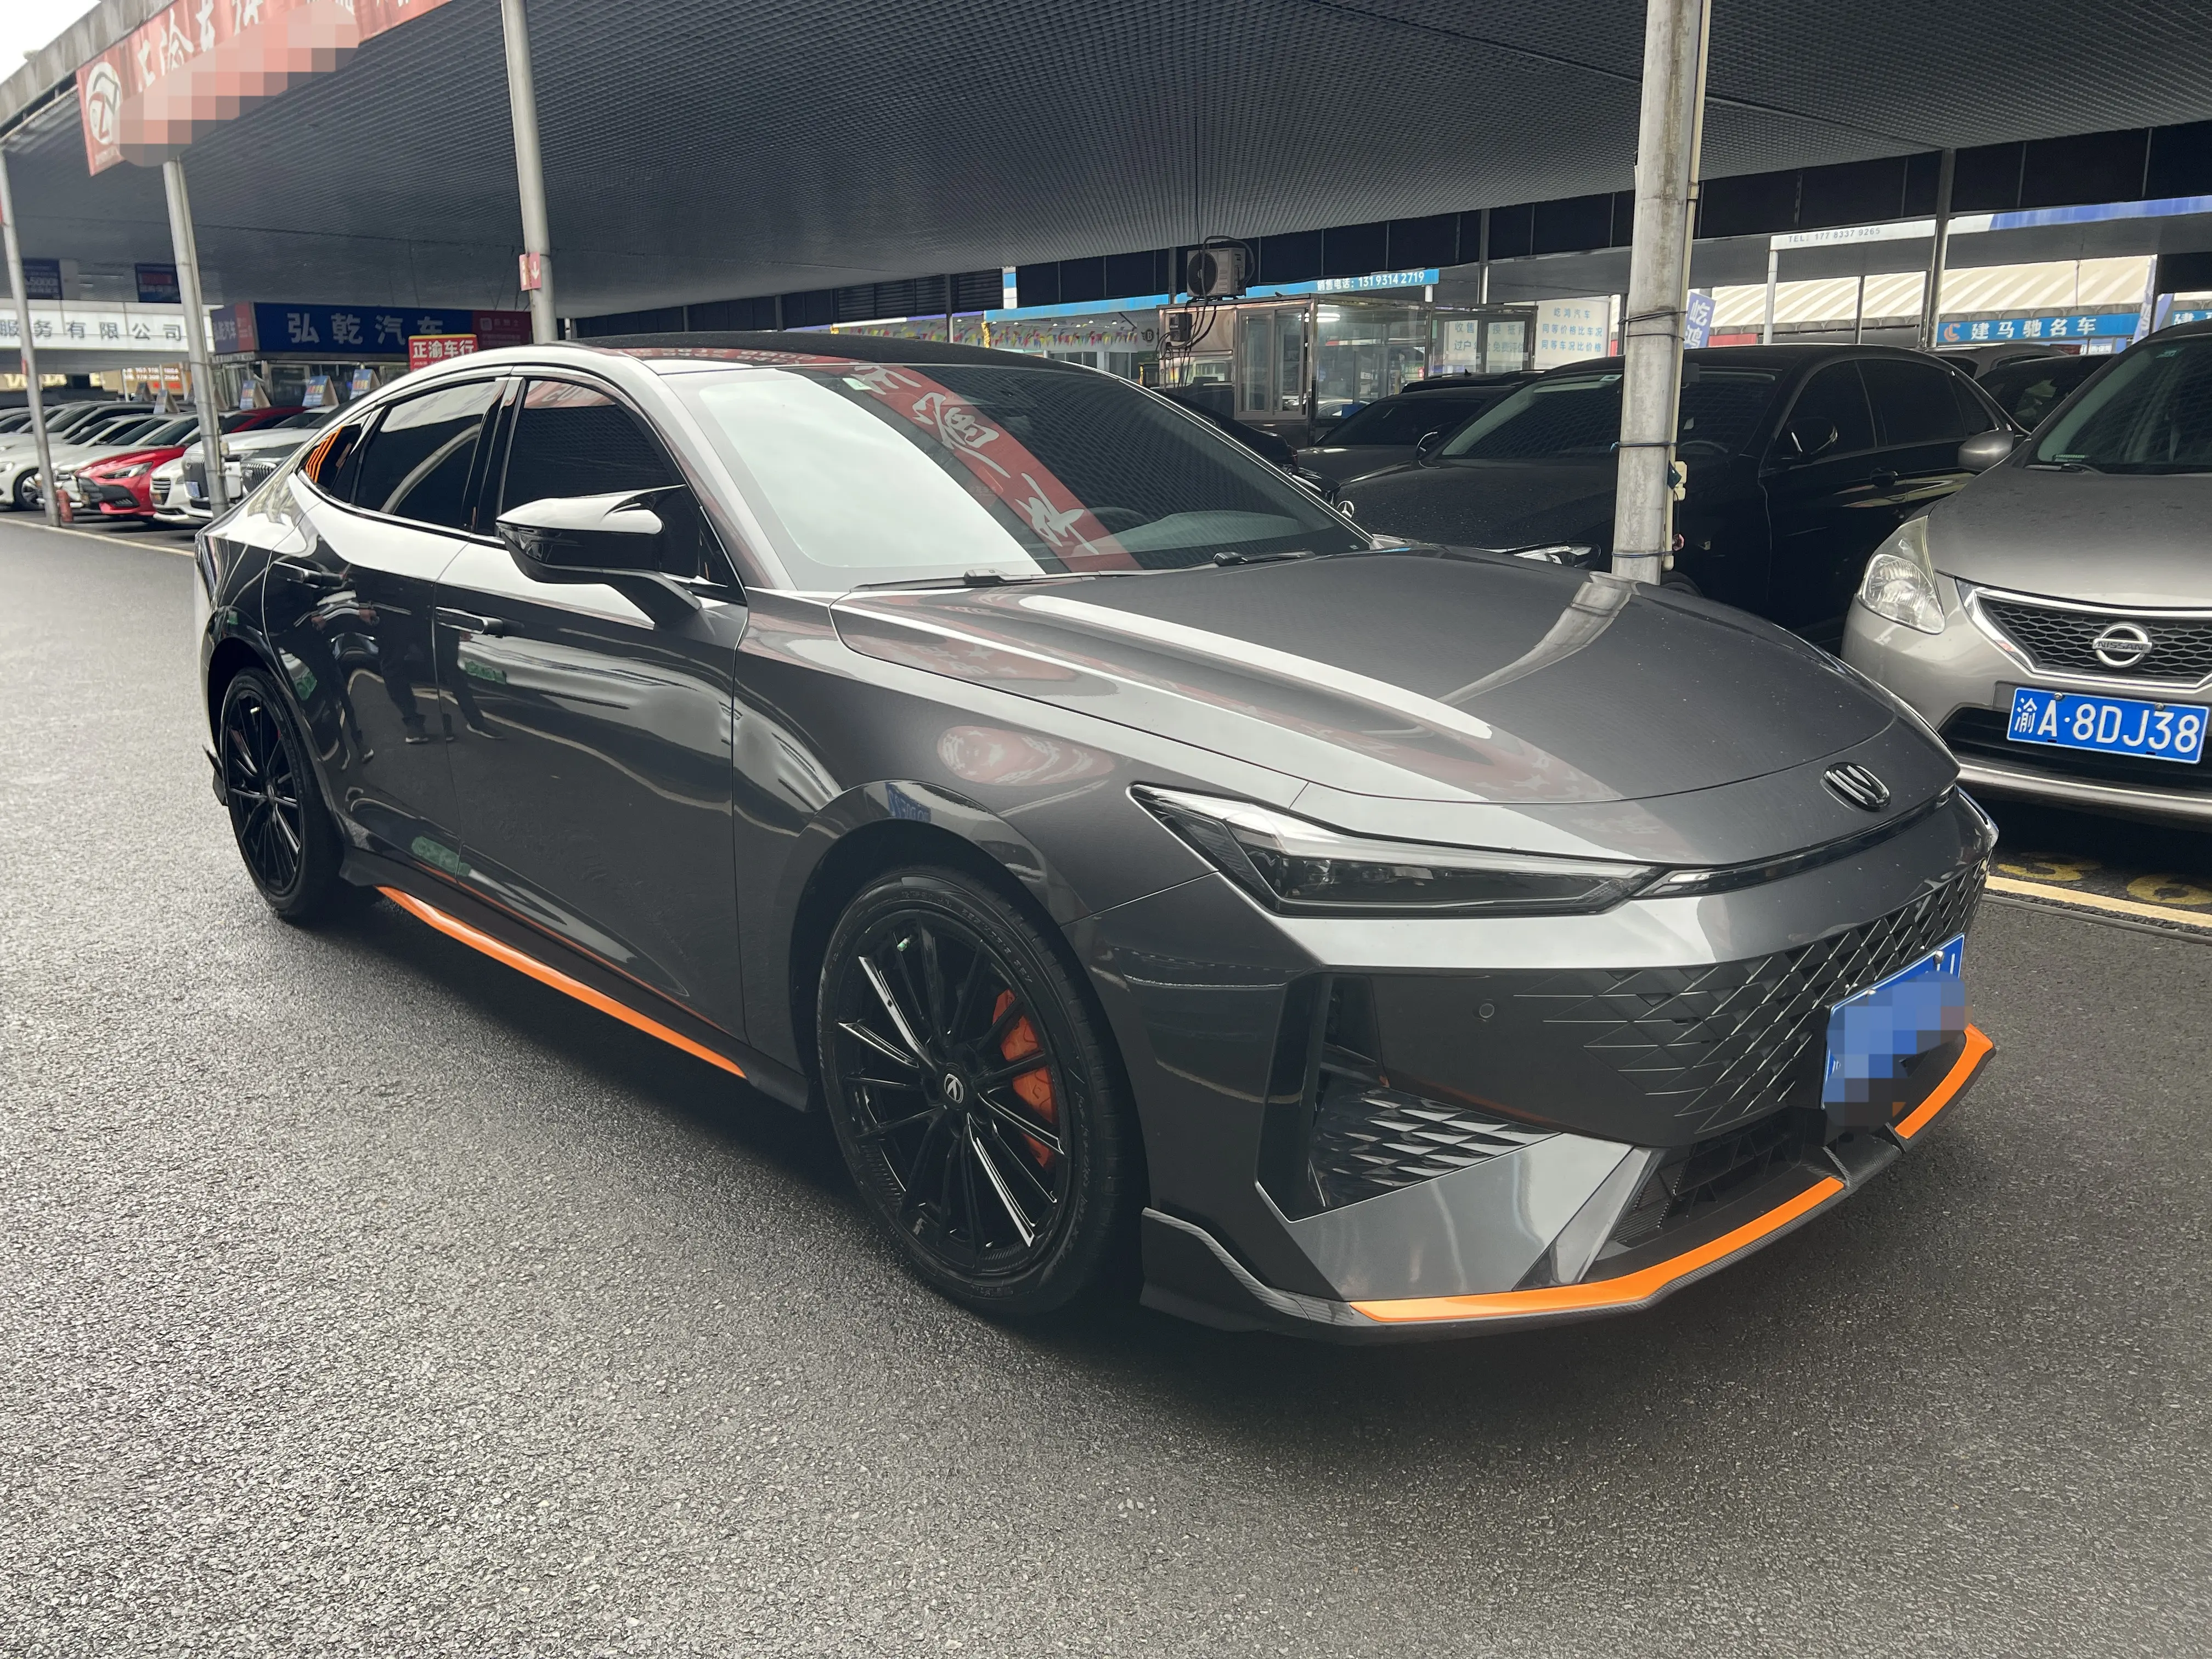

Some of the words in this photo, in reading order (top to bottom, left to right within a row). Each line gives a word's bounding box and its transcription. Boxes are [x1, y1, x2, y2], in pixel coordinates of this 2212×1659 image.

[1814, 232, 1830, 240] 177
[1833, 230, 1855, 238] 8337
[1858, 228, 1880, 236] 9265
[1359, 276, 1373, 287] 131
[1375, 274, 1398, 285] 9314
[1401, 272, 1424, 284] 2719
[1542, 323, 1602, 337] 同等价格比车况
[1971, 317, 2097, 341] 建马驰名车
[413, 339, 474, 358] 正渝车行
[1541, 340, 1601, 352] 同等车况比价格
[2097, 641, 2143, 651] NISSAN
[2014, 697, 2200, 753] 渝A·8DJ38
